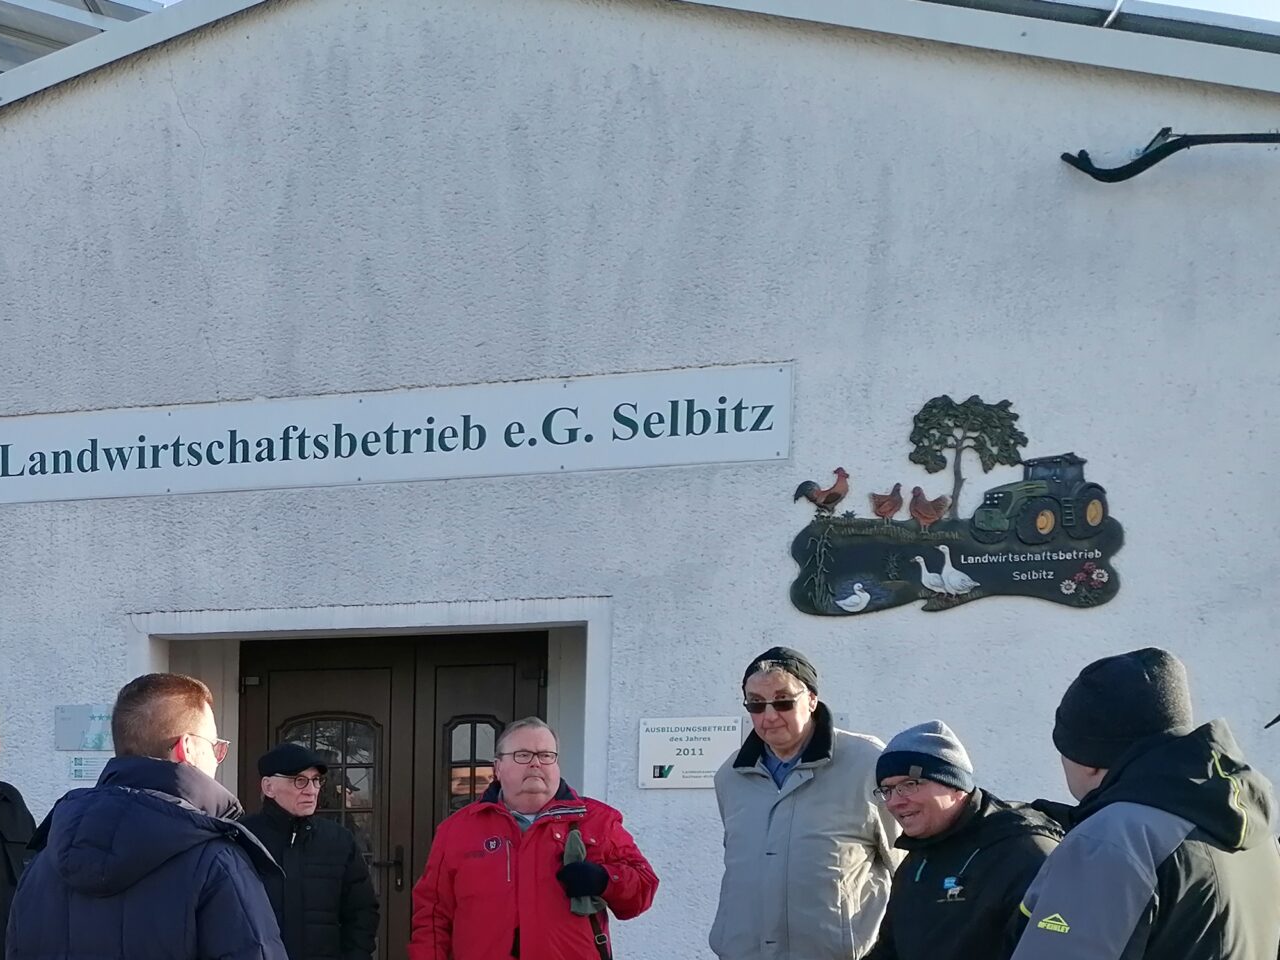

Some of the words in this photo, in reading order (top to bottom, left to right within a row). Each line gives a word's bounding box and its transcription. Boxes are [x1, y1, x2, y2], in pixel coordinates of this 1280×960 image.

[503, 406, 594, 448] e.G.
[612, 395, 774, 442] Selbitz
[960, 548, 1102, 564] Landwirtschaftsbetrieb
[1012, 570, 1054, 581] Selbitz
[645, 725, 737, 733] AUSBILDUNGSBETRIEB
[675, 748, 704, 756] 2011
